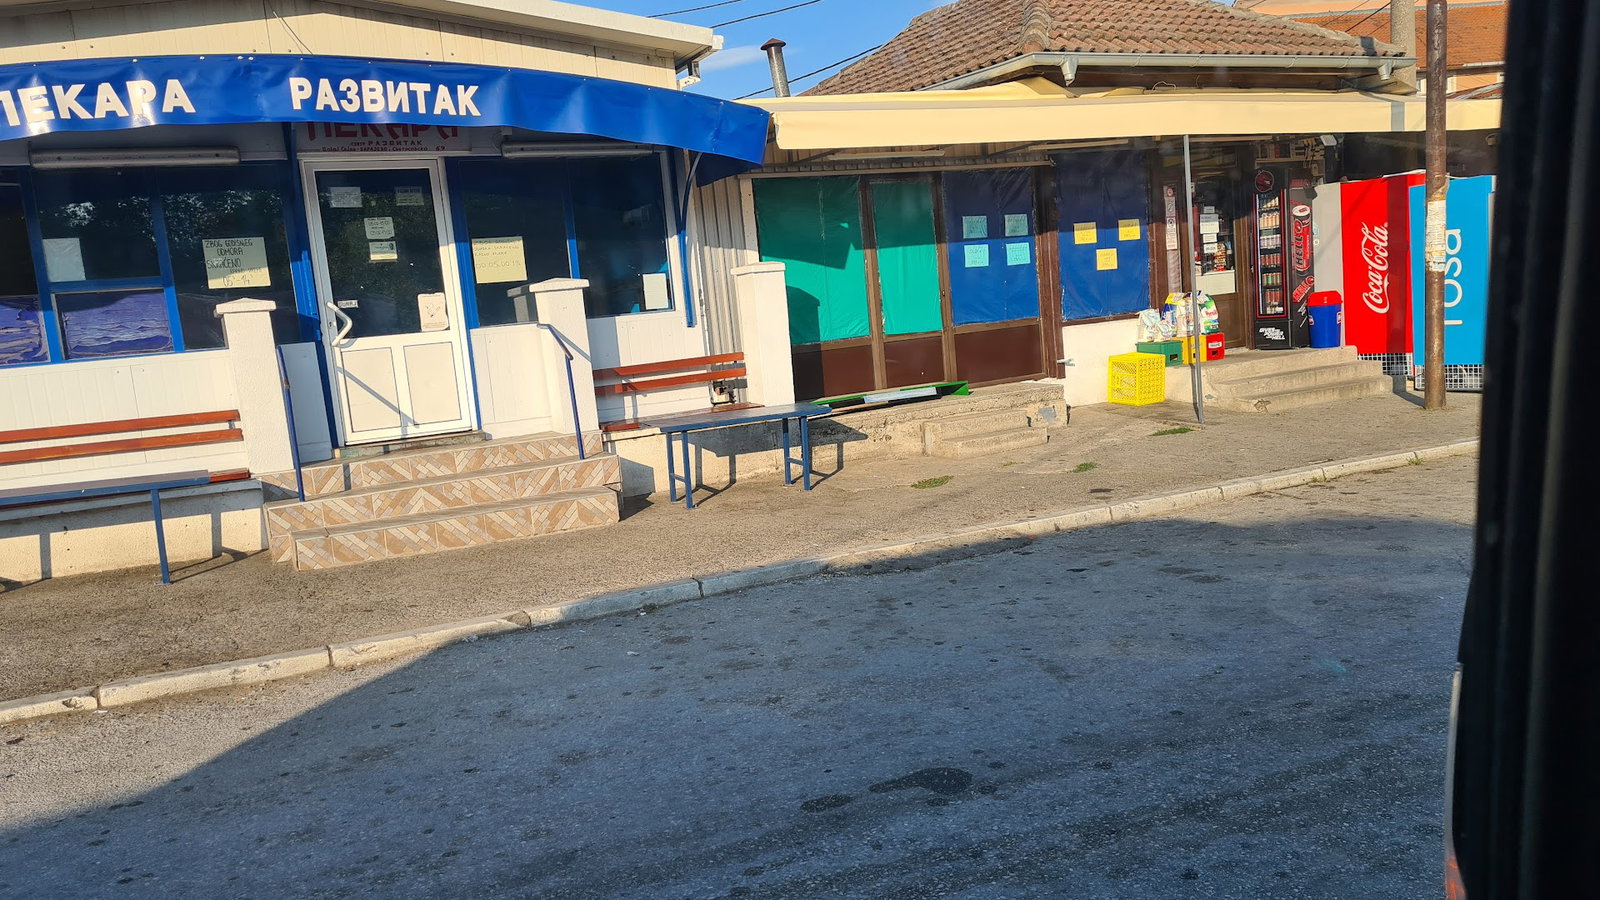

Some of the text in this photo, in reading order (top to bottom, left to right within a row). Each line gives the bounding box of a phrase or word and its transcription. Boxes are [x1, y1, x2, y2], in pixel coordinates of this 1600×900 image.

[289, 77, 481, 117] РАЗВИТАК
[216, 247, 244, 257] ODMORA
[1361, 221, 1389, 314] Coca-Cola
